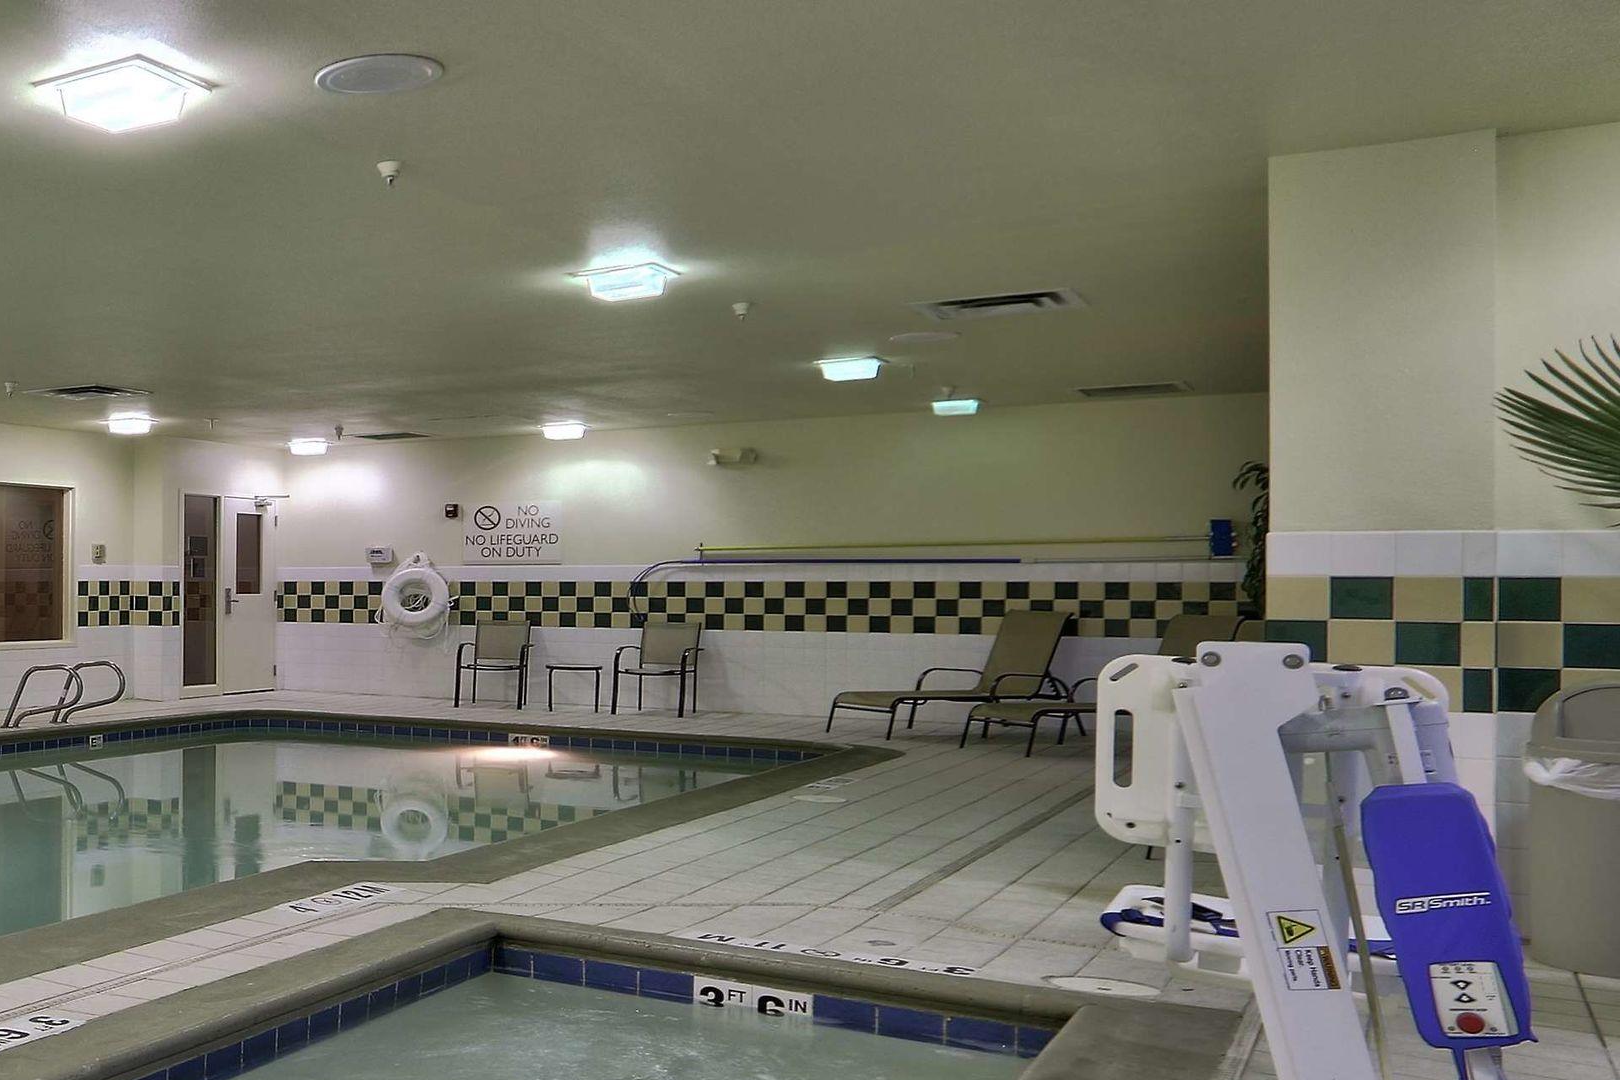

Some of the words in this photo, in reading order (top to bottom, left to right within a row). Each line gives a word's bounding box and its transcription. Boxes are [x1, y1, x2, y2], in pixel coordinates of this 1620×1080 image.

[517, 505, 539, 516] NO
[505, 517, 550, 529] DIVING
[465, 535, 486, 545] NO
[490, 533, 559, 545] LIFEGUARD
[481, 547, 502, 558] ON
[506, 546, 542, 557] DUTY
[1304, 950, 1315, 966] Keep
[1310, 966, 1321, 987] Hands
[698, 986, 725, 1007] 3
[727, 989, 747, 1004] FT
[757, 995, 785, 1017] 6
[788, 998, 807, 1014] IN
[28, 1016, 70, 1026] 3
